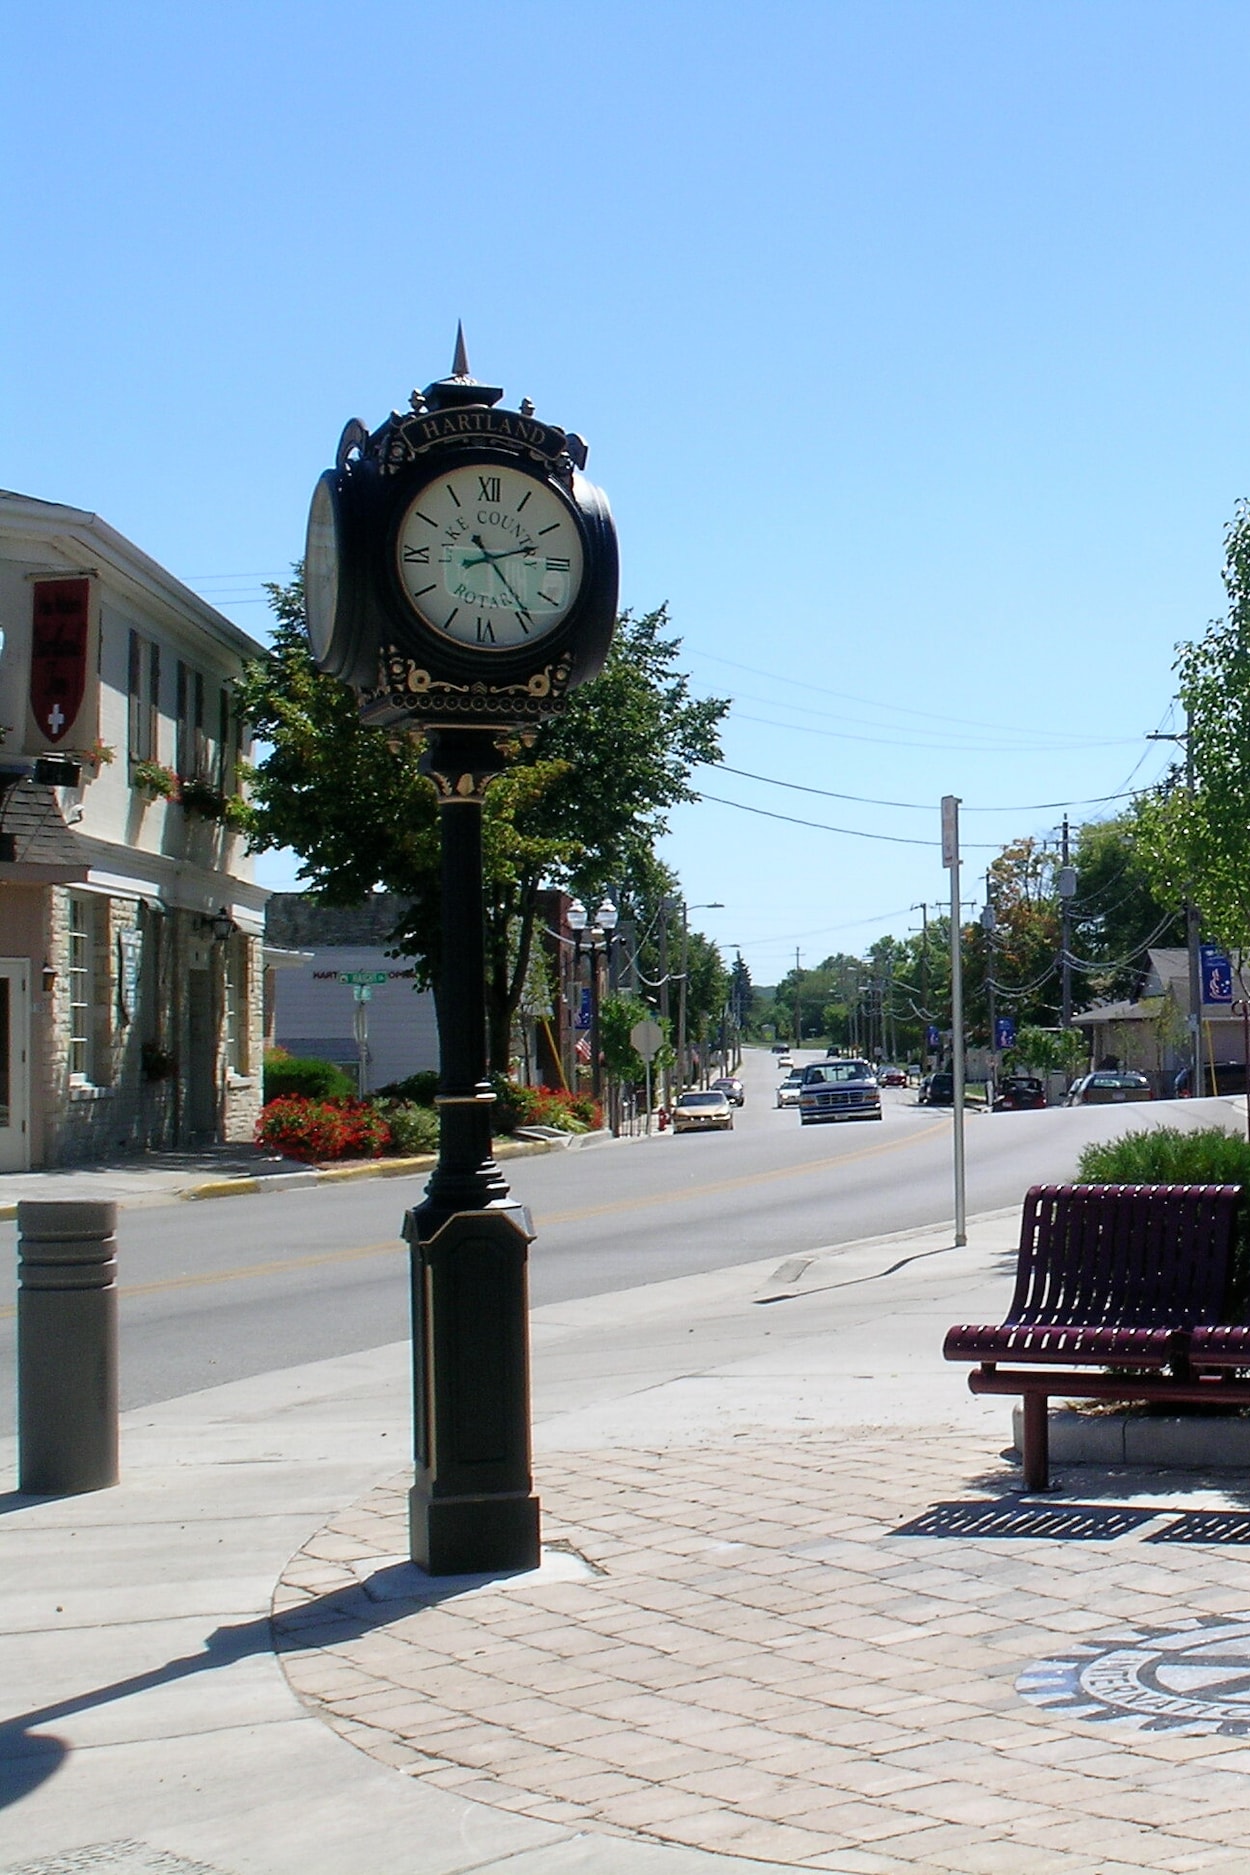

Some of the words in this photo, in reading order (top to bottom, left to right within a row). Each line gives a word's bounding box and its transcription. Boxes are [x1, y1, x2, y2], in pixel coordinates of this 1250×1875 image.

[422, 414, 546, 444] HARTLAND
[478, 476, 501, 502] XII
[438, 517, 470, 563] LAKE
[477, 510, 538, 570] COUNTRY
[453, 583, 520, 609] ROTAR
